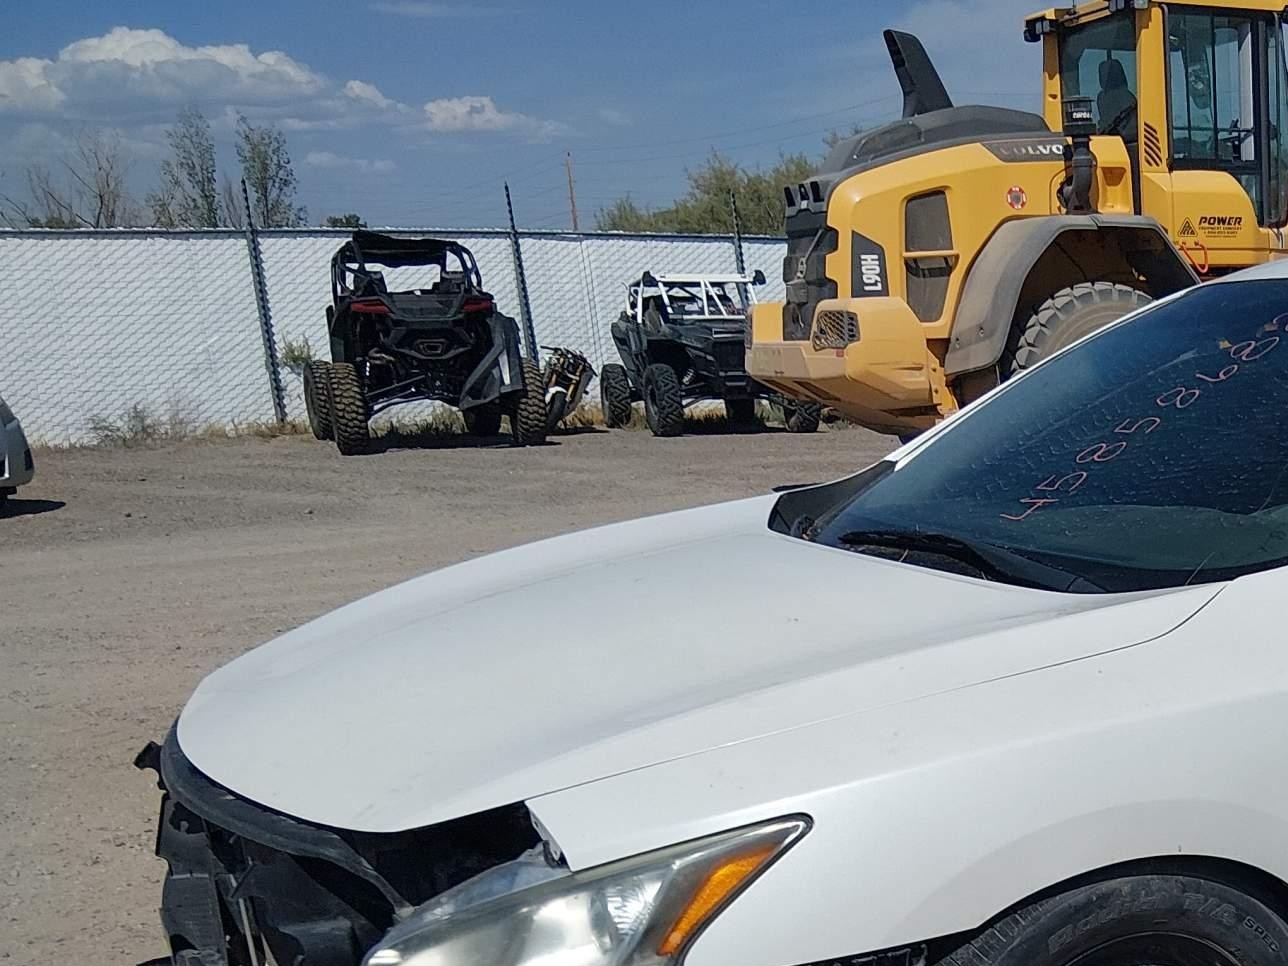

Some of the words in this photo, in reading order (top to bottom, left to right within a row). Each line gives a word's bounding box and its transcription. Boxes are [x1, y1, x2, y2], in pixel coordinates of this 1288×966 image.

[999, 144, 1063, 156] VOLVO
[1198, 216, 1243, 226] POWER
[860, 254, 882, 292] L90H
[1243, 916, 1281, 953] SPEC
